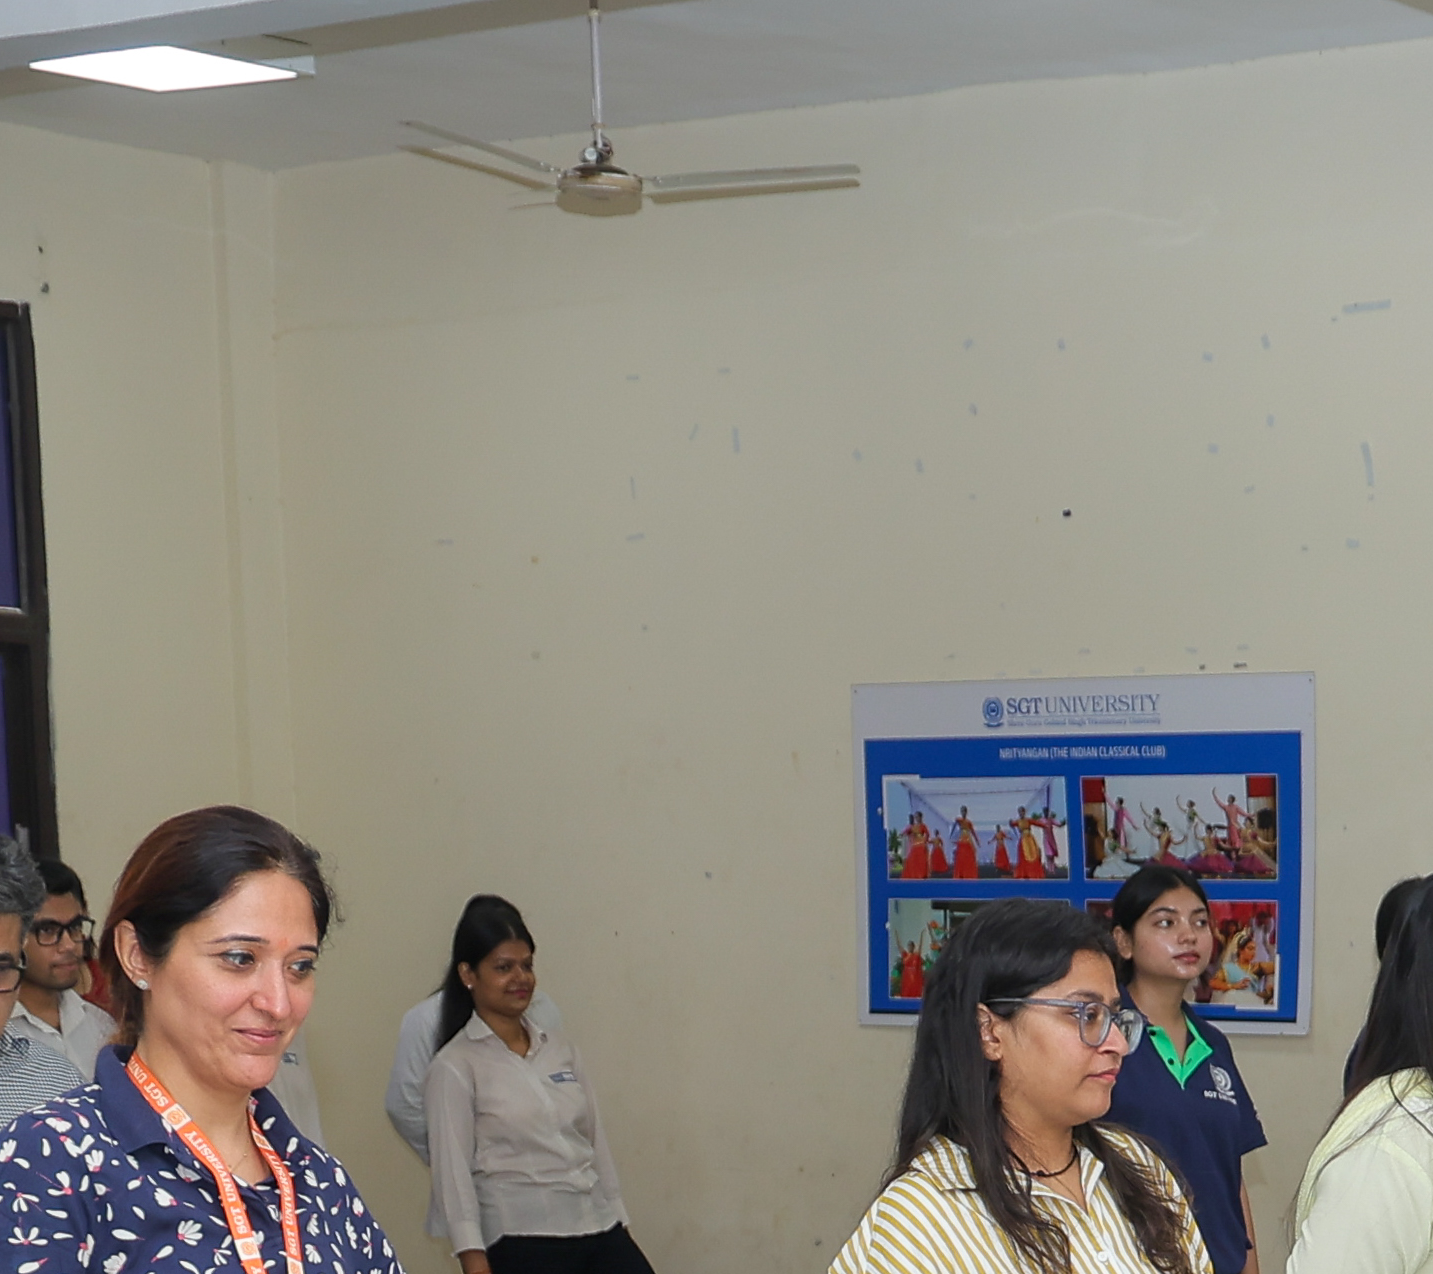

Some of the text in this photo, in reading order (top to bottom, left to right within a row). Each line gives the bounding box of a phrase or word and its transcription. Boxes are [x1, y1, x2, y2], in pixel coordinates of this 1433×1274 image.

[1006, 693, 1161, 715] SGT UNIVERSITY
[1070, 746, 1098, 758] INDIAN
[1099, 745, 1140, 758] CLASSICAL
[143, 1082, 169, 1107] SGT
[185, 1130, 248, 1235] SGT UNIVERSITY
[265, 1151, 298, 1256] SGT UNIVERSITY
